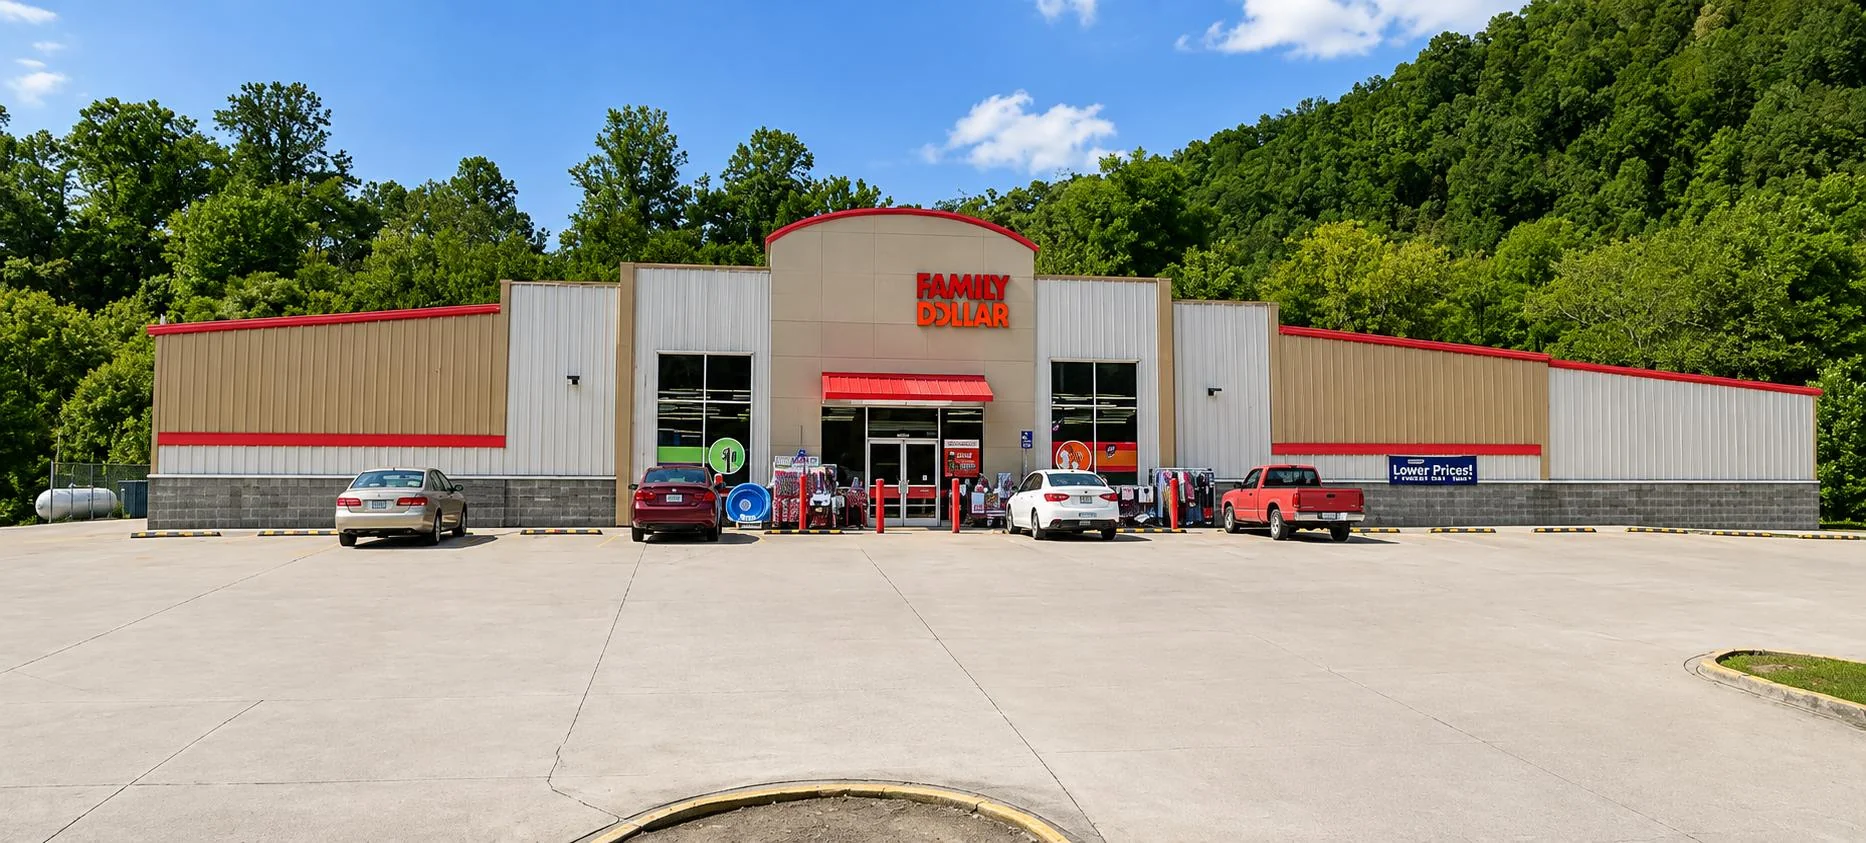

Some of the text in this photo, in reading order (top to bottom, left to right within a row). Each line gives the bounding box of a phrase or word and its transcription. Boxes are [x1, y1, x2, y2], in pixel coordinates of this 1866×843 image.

[917, 273, 1010, 300] FAMILY
[917, 301, 1009, 328] DOLLAR
[1393, 464, 1473, 476] Lower Prices!
